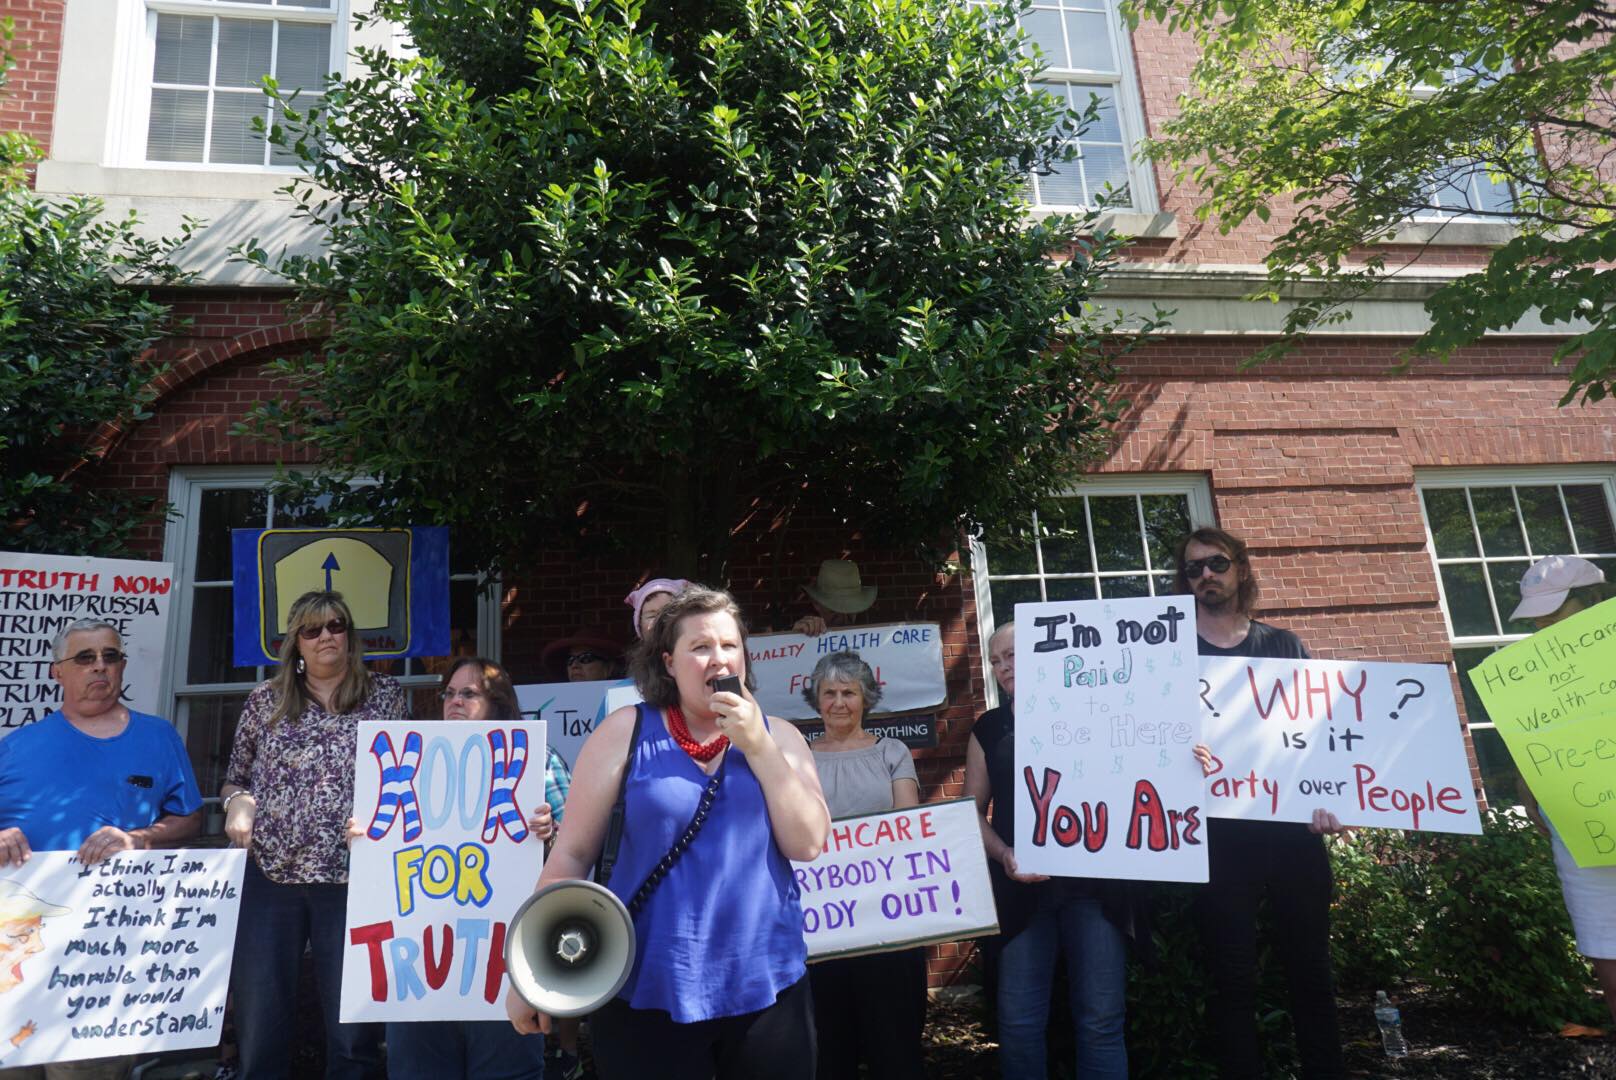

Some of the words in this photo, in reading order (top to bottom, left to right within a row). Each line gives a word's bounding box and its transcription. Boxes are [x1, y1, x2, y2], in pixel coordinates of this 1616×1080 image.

[0, 568, 99, 592] TRUTH
[113, 575, 171, 595] NOW
[0, 591, 160, 616] TRUMP/RUSSIA
[817, 633, 880, 654] HEALTH
[892, 629, 932, 645] CARE
[1033, 612, 1101, 652] I'm
[1116, 606, 1185, 644] not
[1063, 647, 1133, 688] Paid
[1549, 663, 1577, 686] not
[1085, 696, 1110, 716] to
[1247, 665, 1367, 722] WHY
[1389, 678, 1425, 720] ?
[554, 710, 593, 737] Tax
[1051, 720, 1091, 746] Be
[1110, 713, 1193, 748] Here
[1328, 726, 1364, 751] it
[1299, 778, 1347, 795] over
[1352, 763, 1467, 829] People
[99, 858, 156, 877] think
[160, 854, 178, 876] I
[904, 848, 951, 881] IN
[92, 879, 166, 903] actually
[174, 879, 237, 899] humble
[393, 841, 493, 917] FOR
[82, 906, 105, 930] I
[104, 905, 167, 927] think
[171, 905, 217, 931] I'm
[64, 934, 127, 957] much
[140, 938, 199, 956] more
[48, 964, 136, 990] humble
[146, 962, 201, 984] than
[66, 993, 111, 1019] you
[123, 986, 185, 1007] would
